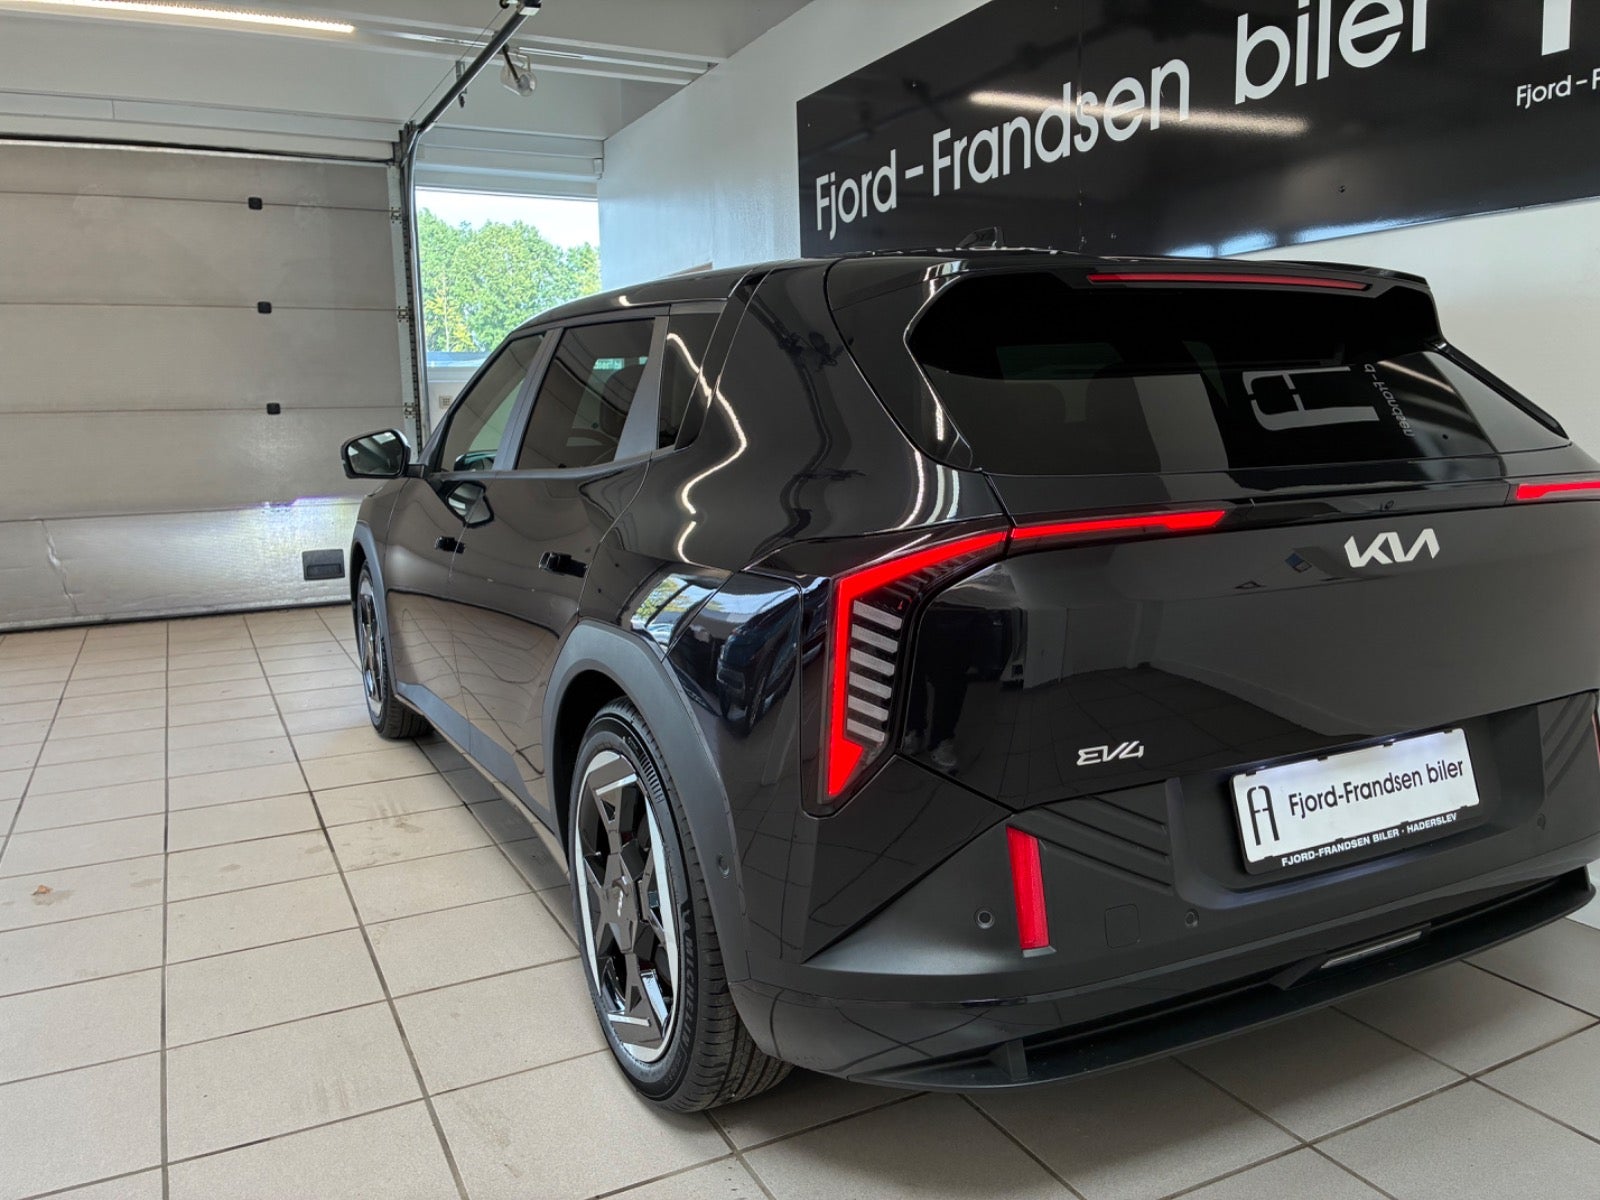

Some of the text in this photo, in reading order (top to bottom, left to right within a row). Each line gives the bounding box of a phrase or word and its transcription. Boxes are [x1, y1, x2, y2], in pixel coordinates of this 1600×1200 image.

[1344, 528, 1440, 568] KIA
[1076, 740, 1145, 766] EV4
[1288, 760, 1464, 819] Fjord-Frandsen biler
[1281, 812, 1458, 867] FJORD-FRANDSEN BILER HADERSLEV
[680, 936, 696, 1049] MICHELIN
